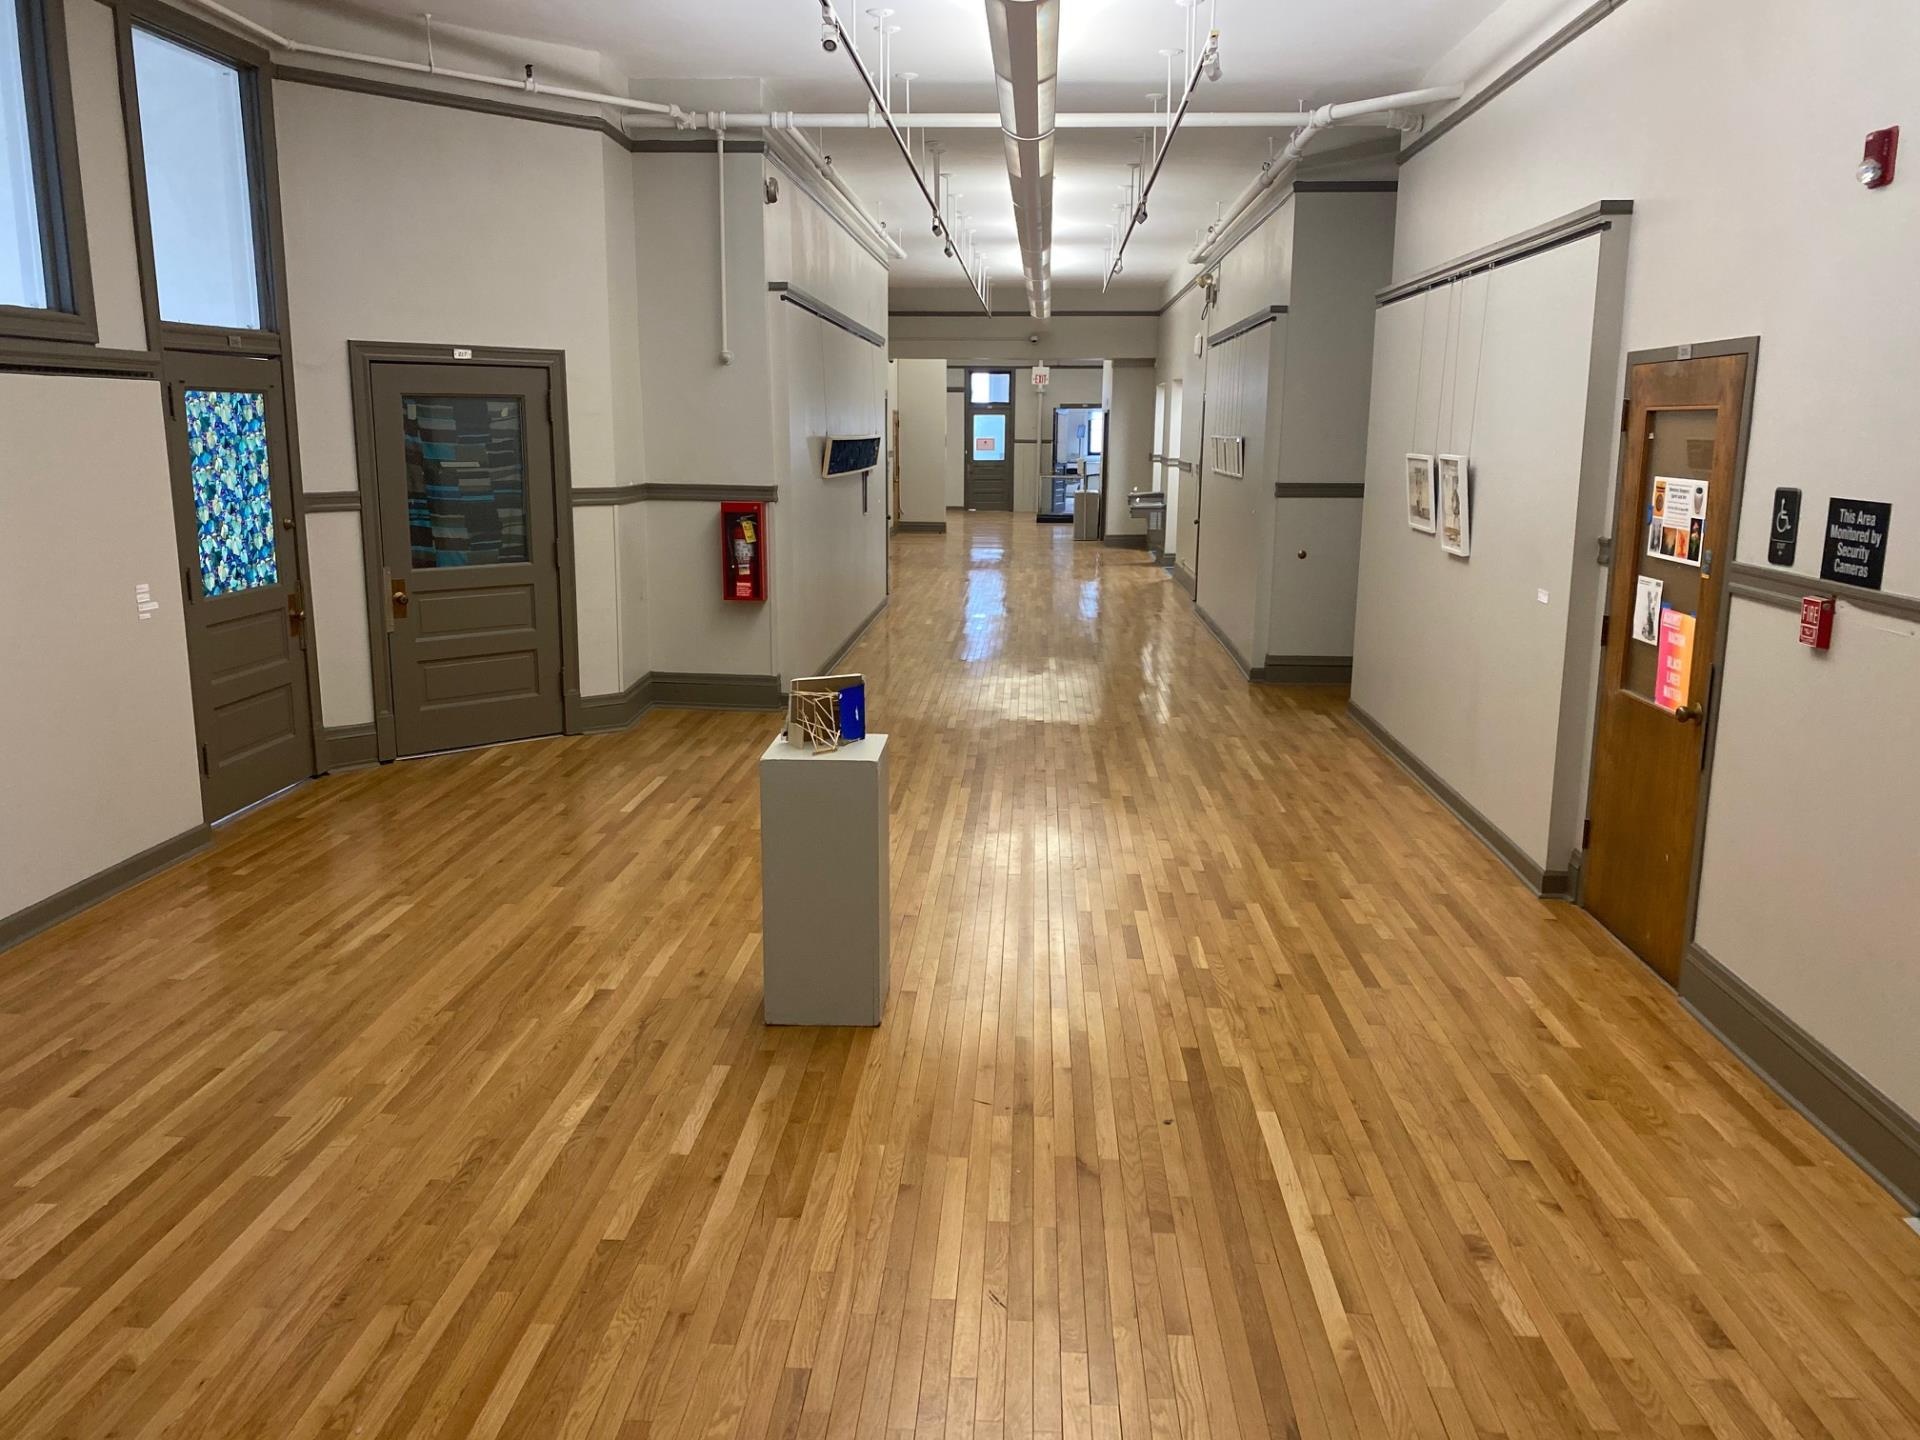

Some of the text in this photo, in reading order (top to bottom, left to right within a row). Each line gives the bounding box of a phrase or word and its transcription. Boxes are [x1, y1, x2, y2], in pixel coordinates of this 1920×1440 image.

[1034, 374, 1047, 384] EXIT
[1839, 508, 1877, 527] This Area
[1829, 524, 1883, 548] Monitored by
[1836, 542, 1870, 564] Security
[1833, 558, 1869, 578] Cameras
[1802, 604, 1819, 624] FIRE
